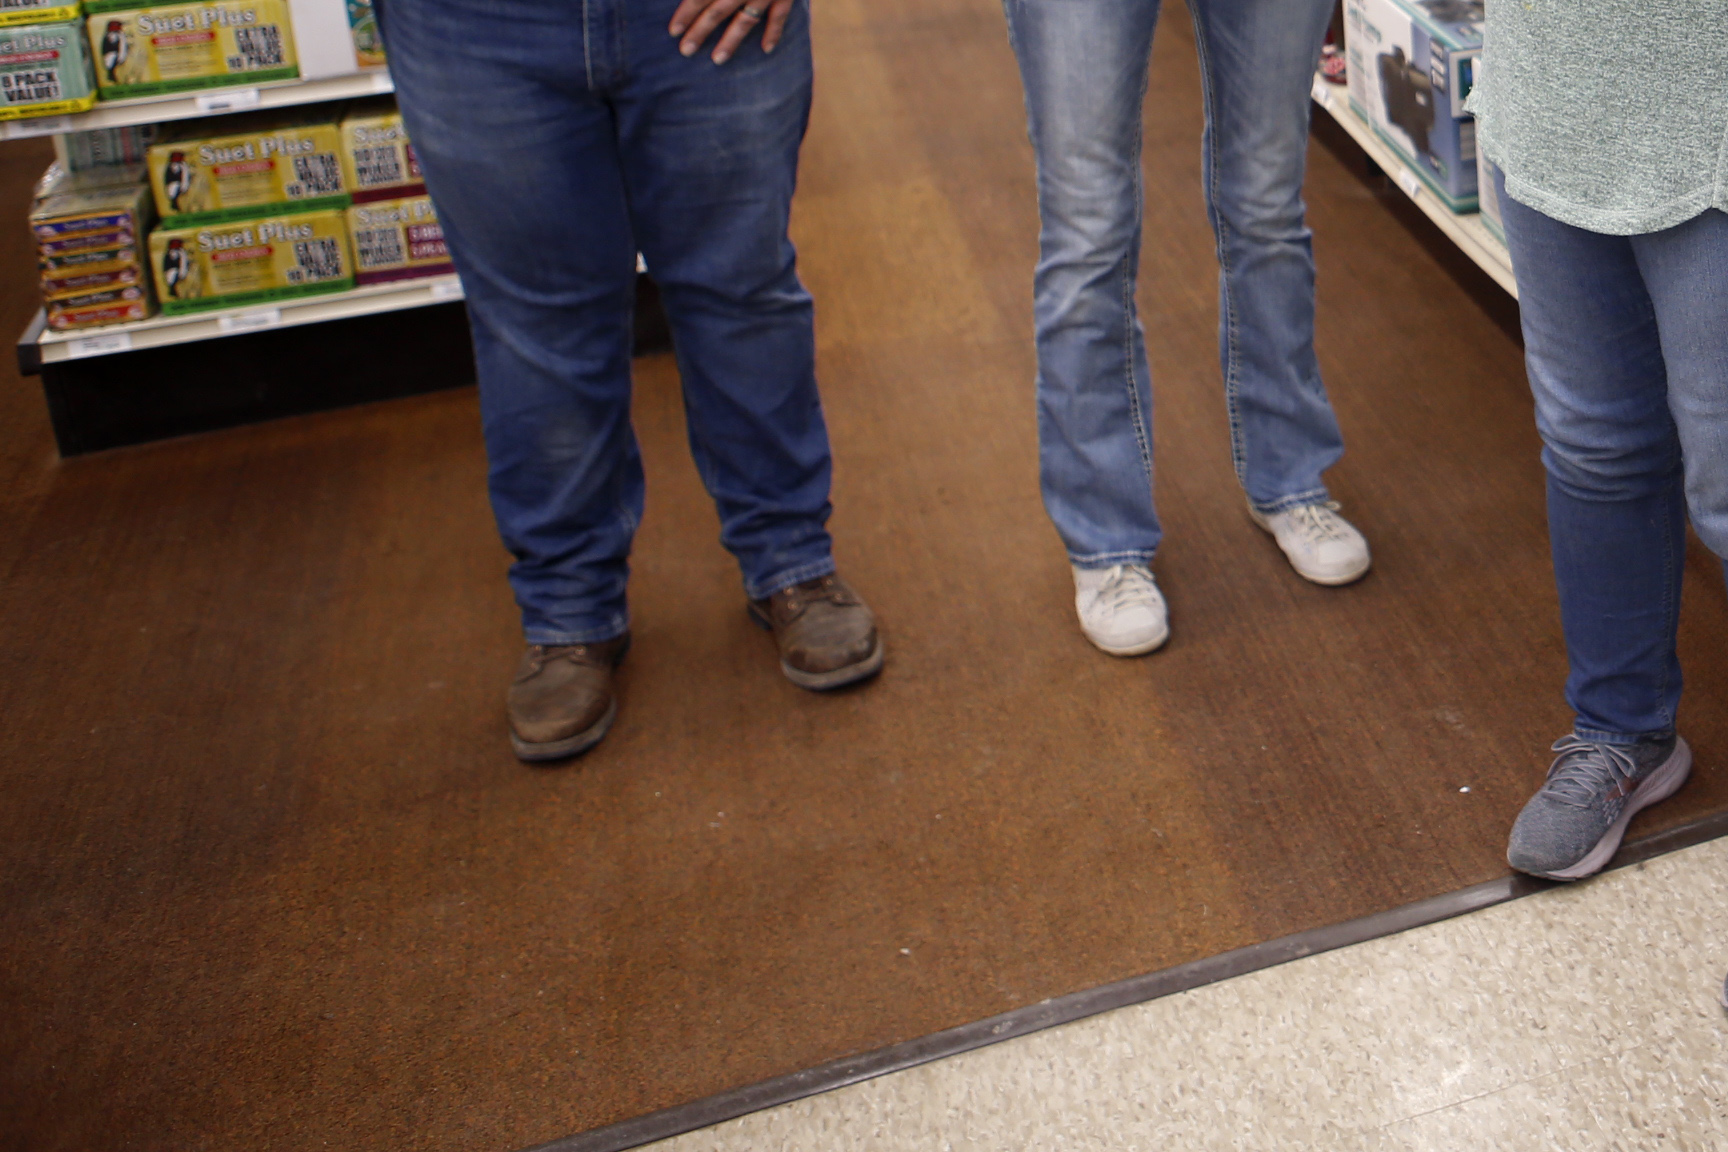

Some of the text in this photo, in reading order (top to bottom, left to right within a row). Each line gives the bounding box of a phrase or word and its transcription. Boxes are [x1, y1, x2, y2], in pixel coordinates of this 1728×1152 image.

[137, 5, 257, 36] Suet Plus
[23, 33, 66, 50] Plus
[15, 71, 58, 88] PACK
[4, 84, 60, 104] VALUE!
[200, 136, 315, 166] Suet Plus
[197, 223, 314, 253] Suet Plus
